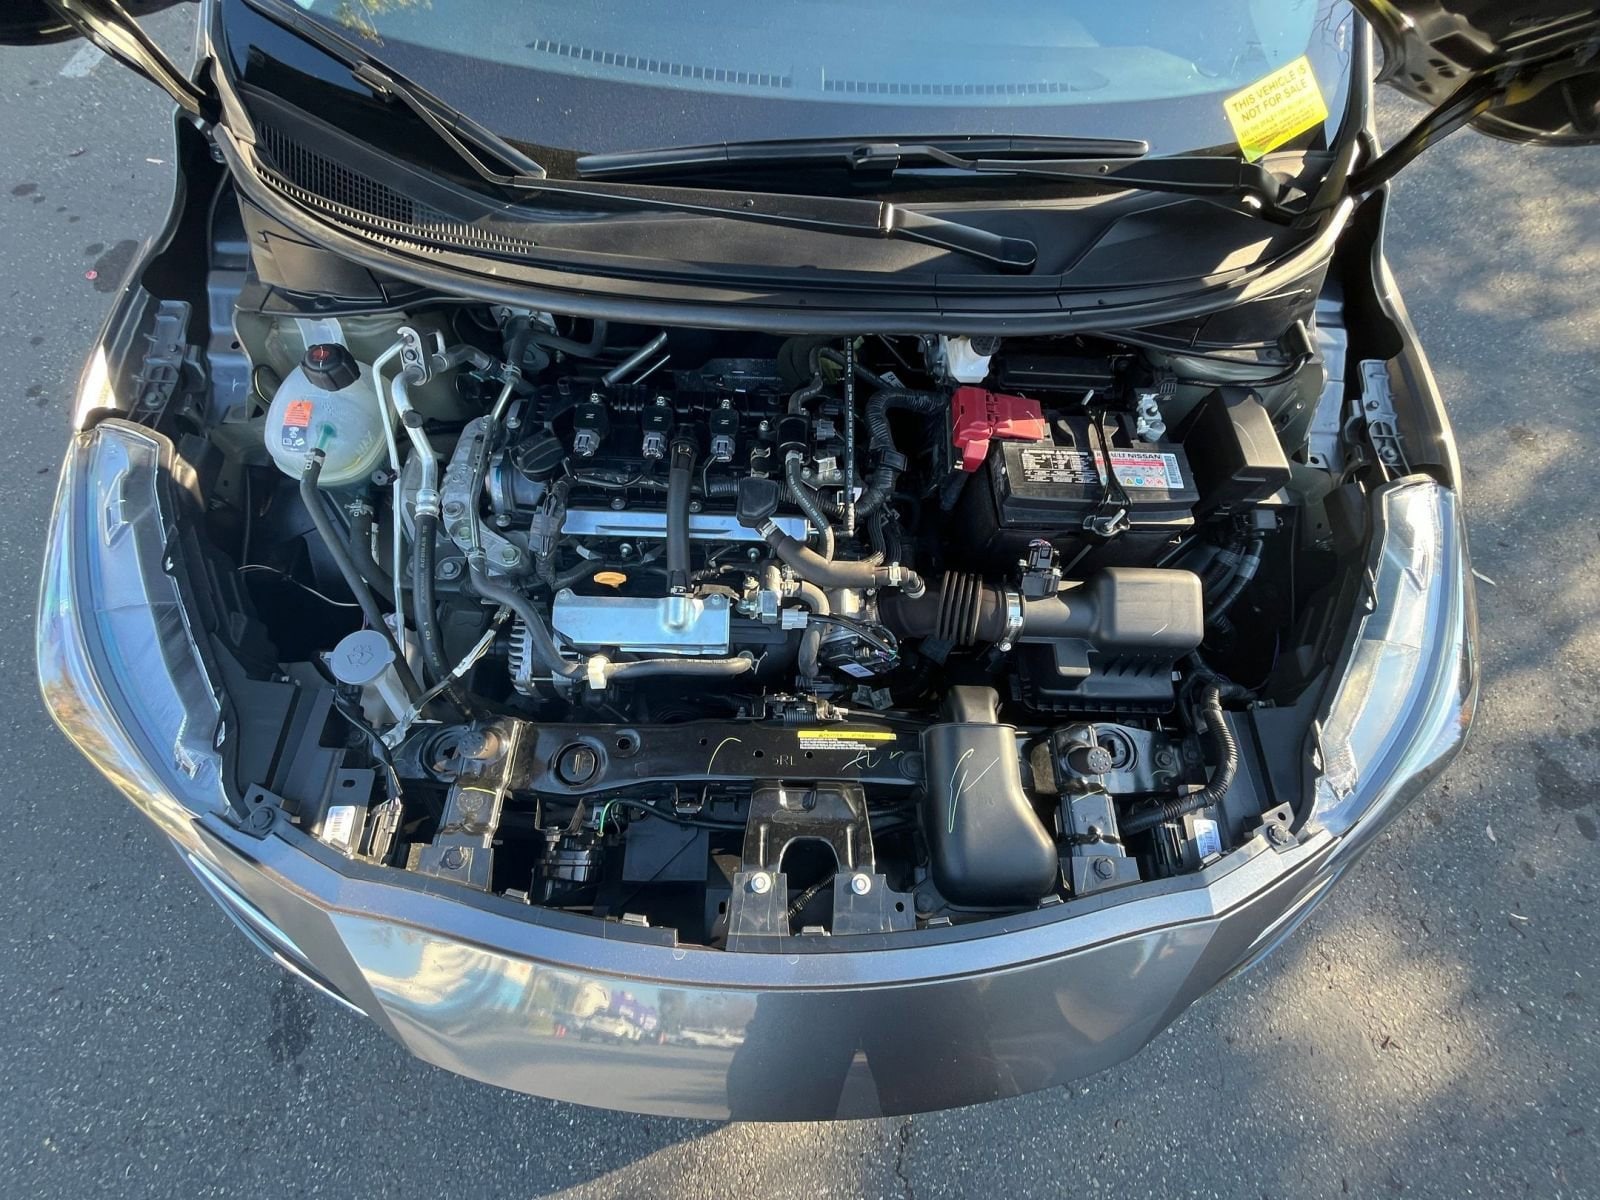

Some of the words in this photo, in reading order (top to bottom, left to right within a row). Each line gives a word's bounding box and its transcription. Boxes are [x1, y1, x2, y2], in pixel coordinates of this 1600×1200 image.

[1232, 94, 1255, 112] THIS
[1257, 70, 1296, 98] VEHICLE
[1298, 64, 1307, 76] IS
[1241, 105, 1261, 122] NOT
[1263, 94, 1282, 110] FOR
[1283, 79, 1307, 98] SALE
